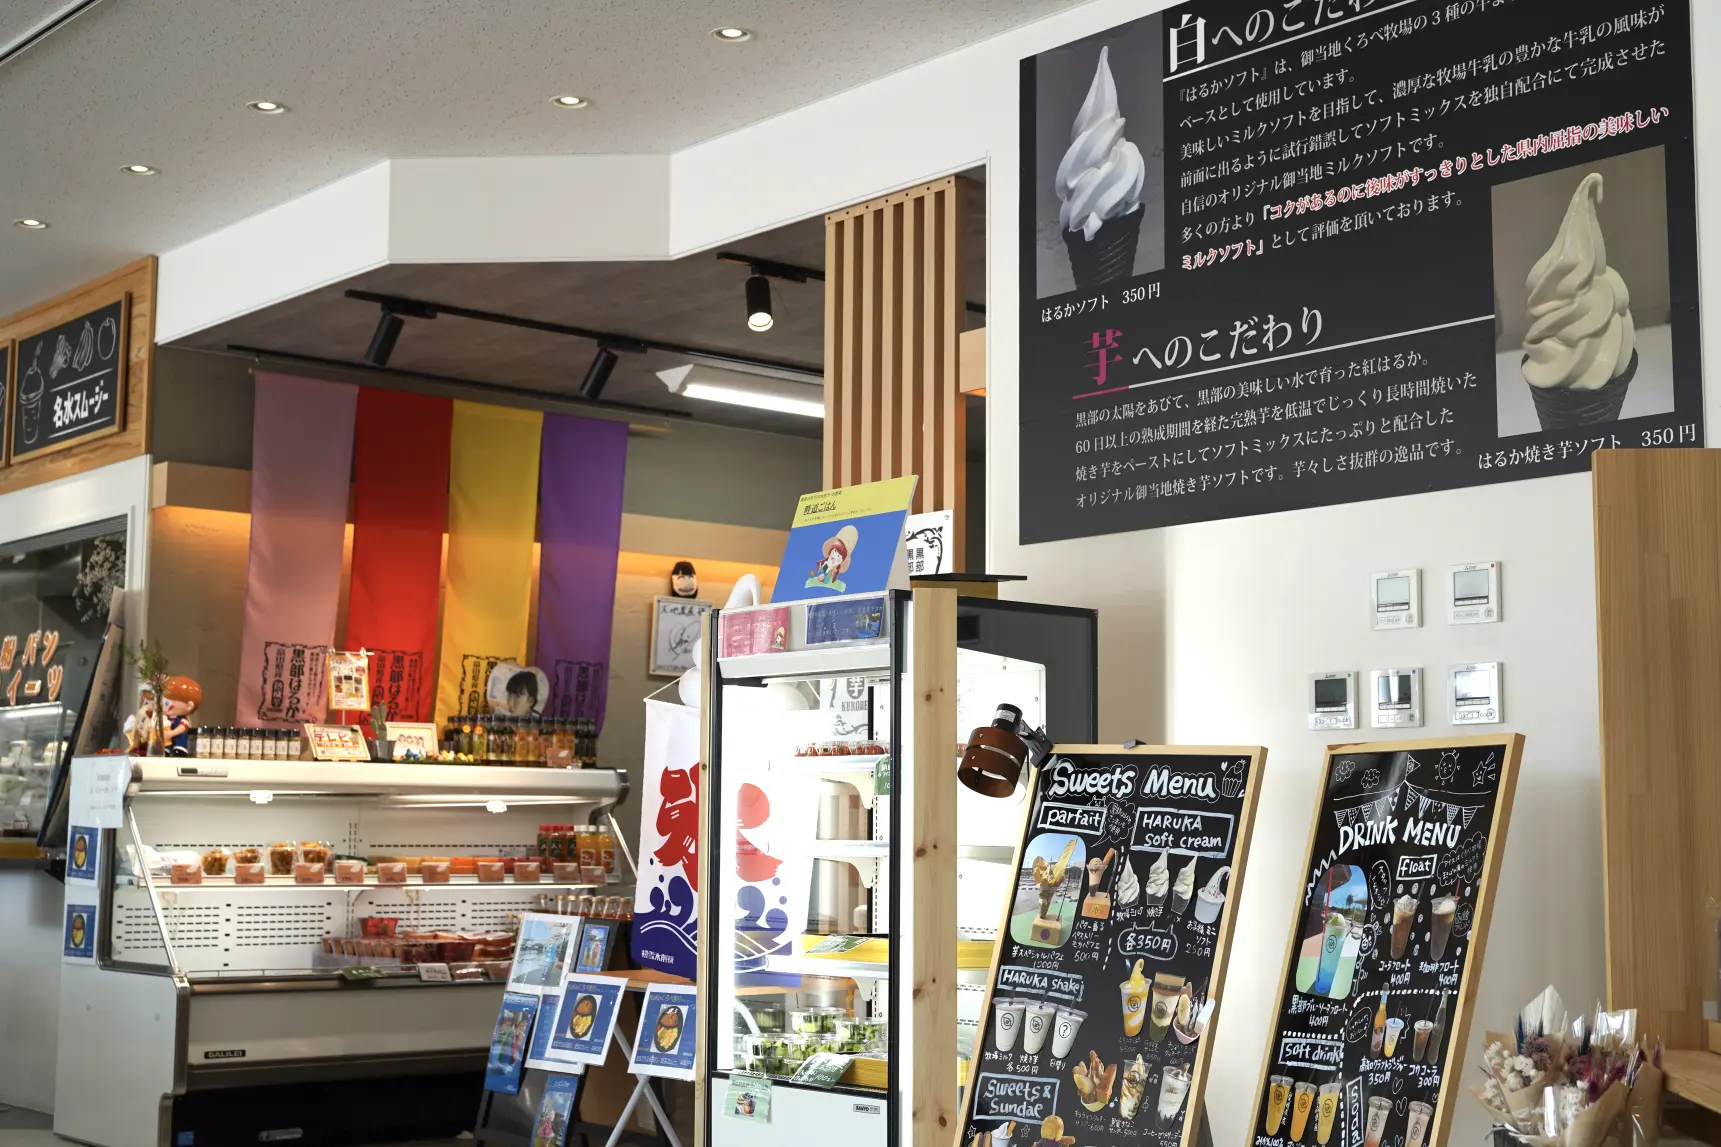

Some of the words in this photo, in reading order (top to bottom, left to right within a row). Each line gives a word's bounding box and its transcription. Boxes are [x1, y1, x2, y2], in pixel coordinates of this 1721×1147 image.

[1180, 4, 1665, 160] 美味しいミルクソフトを目指して、濃厚な牧場牛乳の豊かな牛乳の風味が
[1180, 69, 1355, 128] ベースとして使用しています。
[1180, 39, 1666, 187] 前面に出るように試行錯誤してソフトミックスを独自配合にて完成させた
[1181, 133, 1444, 215] 自信のオリジナル御当地ミルクソフトです。
[1041, 294, 1109, 323] はるかソフト
[1122, 282, 1161, 304] 350円
[1083, 306, 1323, 385] 芋へのこだわり
[53, 380, 109, 428] 名水スムージー
[1075, 351, 1428, 428] 黒部の太陽をあびて、黒部の美味しい水で育った紅はるか。
[1075, 407, 1454, 483] 焼き芋をペーストにしてソフトミックスにたっぷりと配合した
[1478, 434, 1621, 469] はるか焼き芋ソフト
[1641, 423, 1696, 447] 350円
[841, 701, 868, 712] KUROBE
[1049, 760, 1136, 797] Sweets
[1143, 768, 1216, 799] Menu
[1047, 809, 1102, 828] parfait
[1143, 814, 1203, 832] HARUKA
[1179, 835, 1222, 849] cream
[1339, 816, 1398, 855] DRINK
[1402, 817, 1461, 848] MENU
[1125, 933, 1172, 953] 各350円
[1186, 943, 1211, 957] 250円
[1003, 970, 1048, 988] HARUKA
[1309, 1014, 1329, 1027] 400円
[983, 1079, 1041, 1102] Sweets
[1368, 1071, 1391, 1085] 350円
[1418, 1075, 1440, 1088] 300円
[989, 1098, 1043, 1118] Sundae
